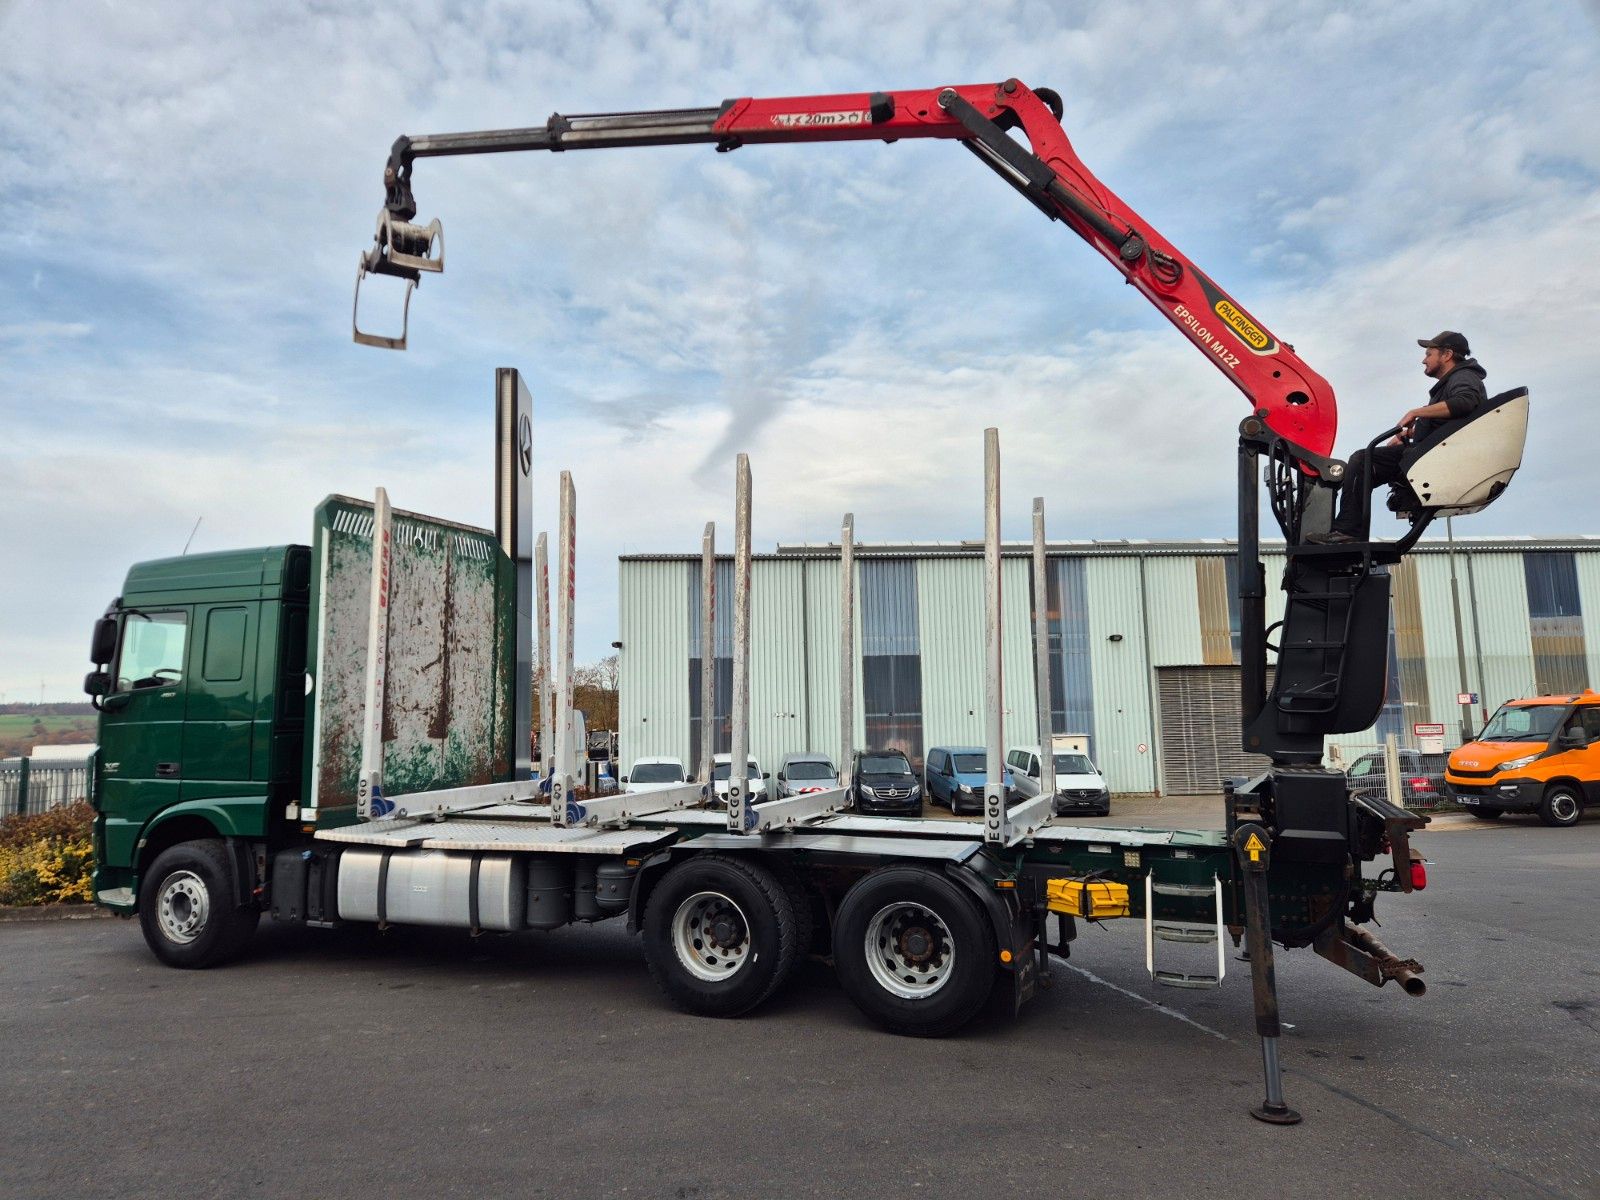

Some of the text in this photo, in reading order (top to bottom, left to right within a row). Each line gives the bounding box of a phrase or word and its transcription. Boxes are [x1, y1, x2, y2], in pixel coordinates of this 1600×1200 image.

[1173, 305, 1241, 369] EPSILON M12Z
[1217, 303, 1264, 345] PALFINGER
